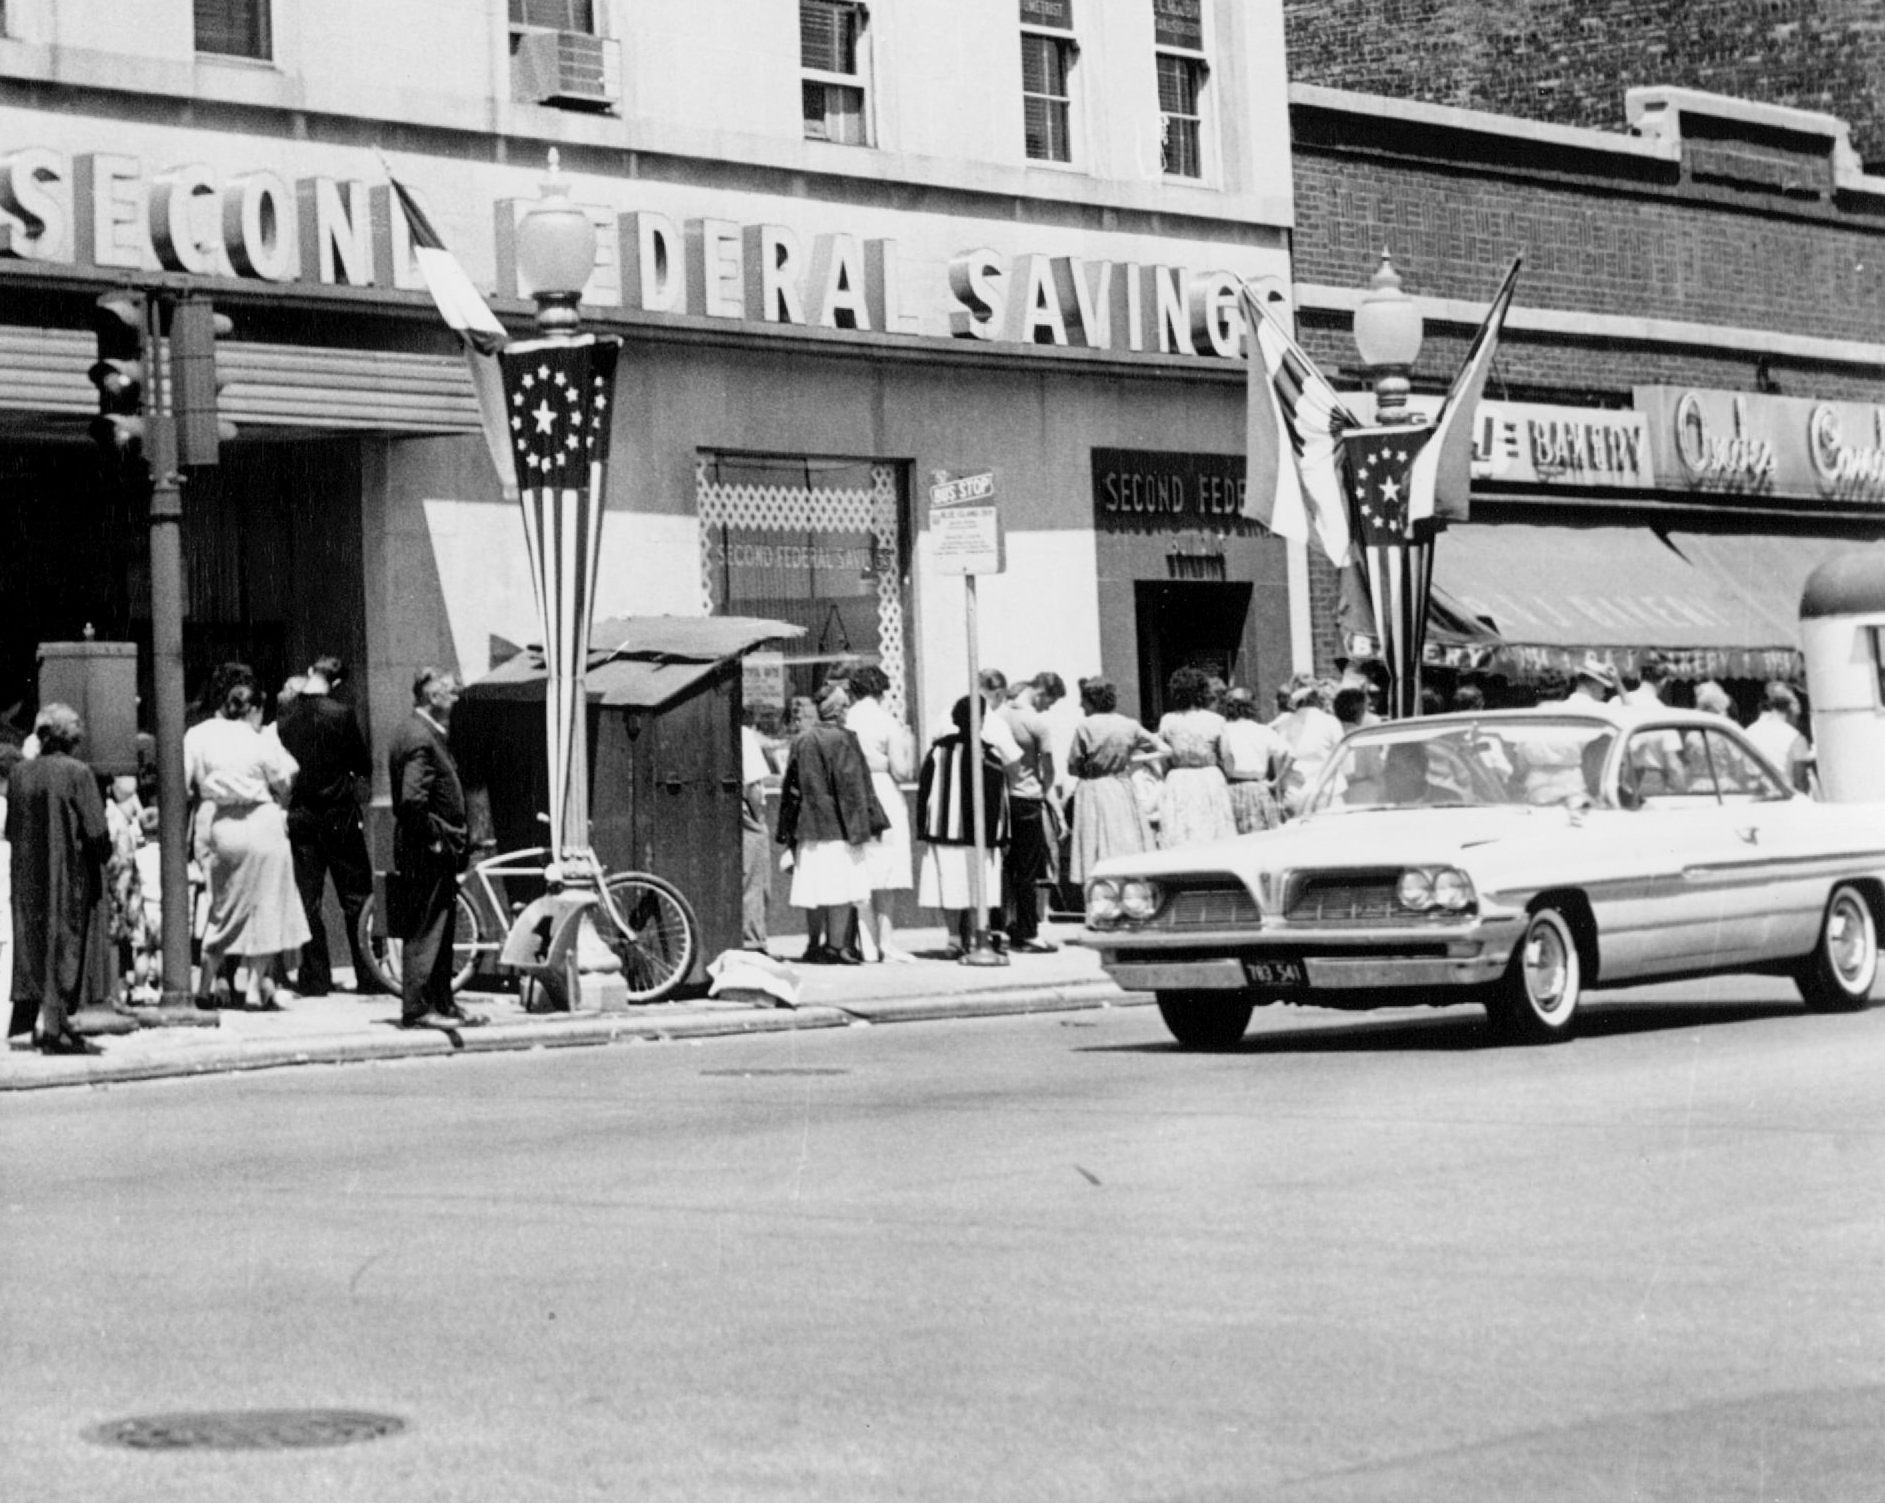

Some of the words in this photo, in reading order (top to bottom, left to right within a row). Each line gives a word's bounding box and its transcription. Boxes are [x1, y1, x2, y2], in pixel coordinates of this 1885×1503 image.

[958, 476, 990, 498] STOP
[1105, 471, 1183, 513] SECOND
[776, 546, 833, 569] FEDERAL
